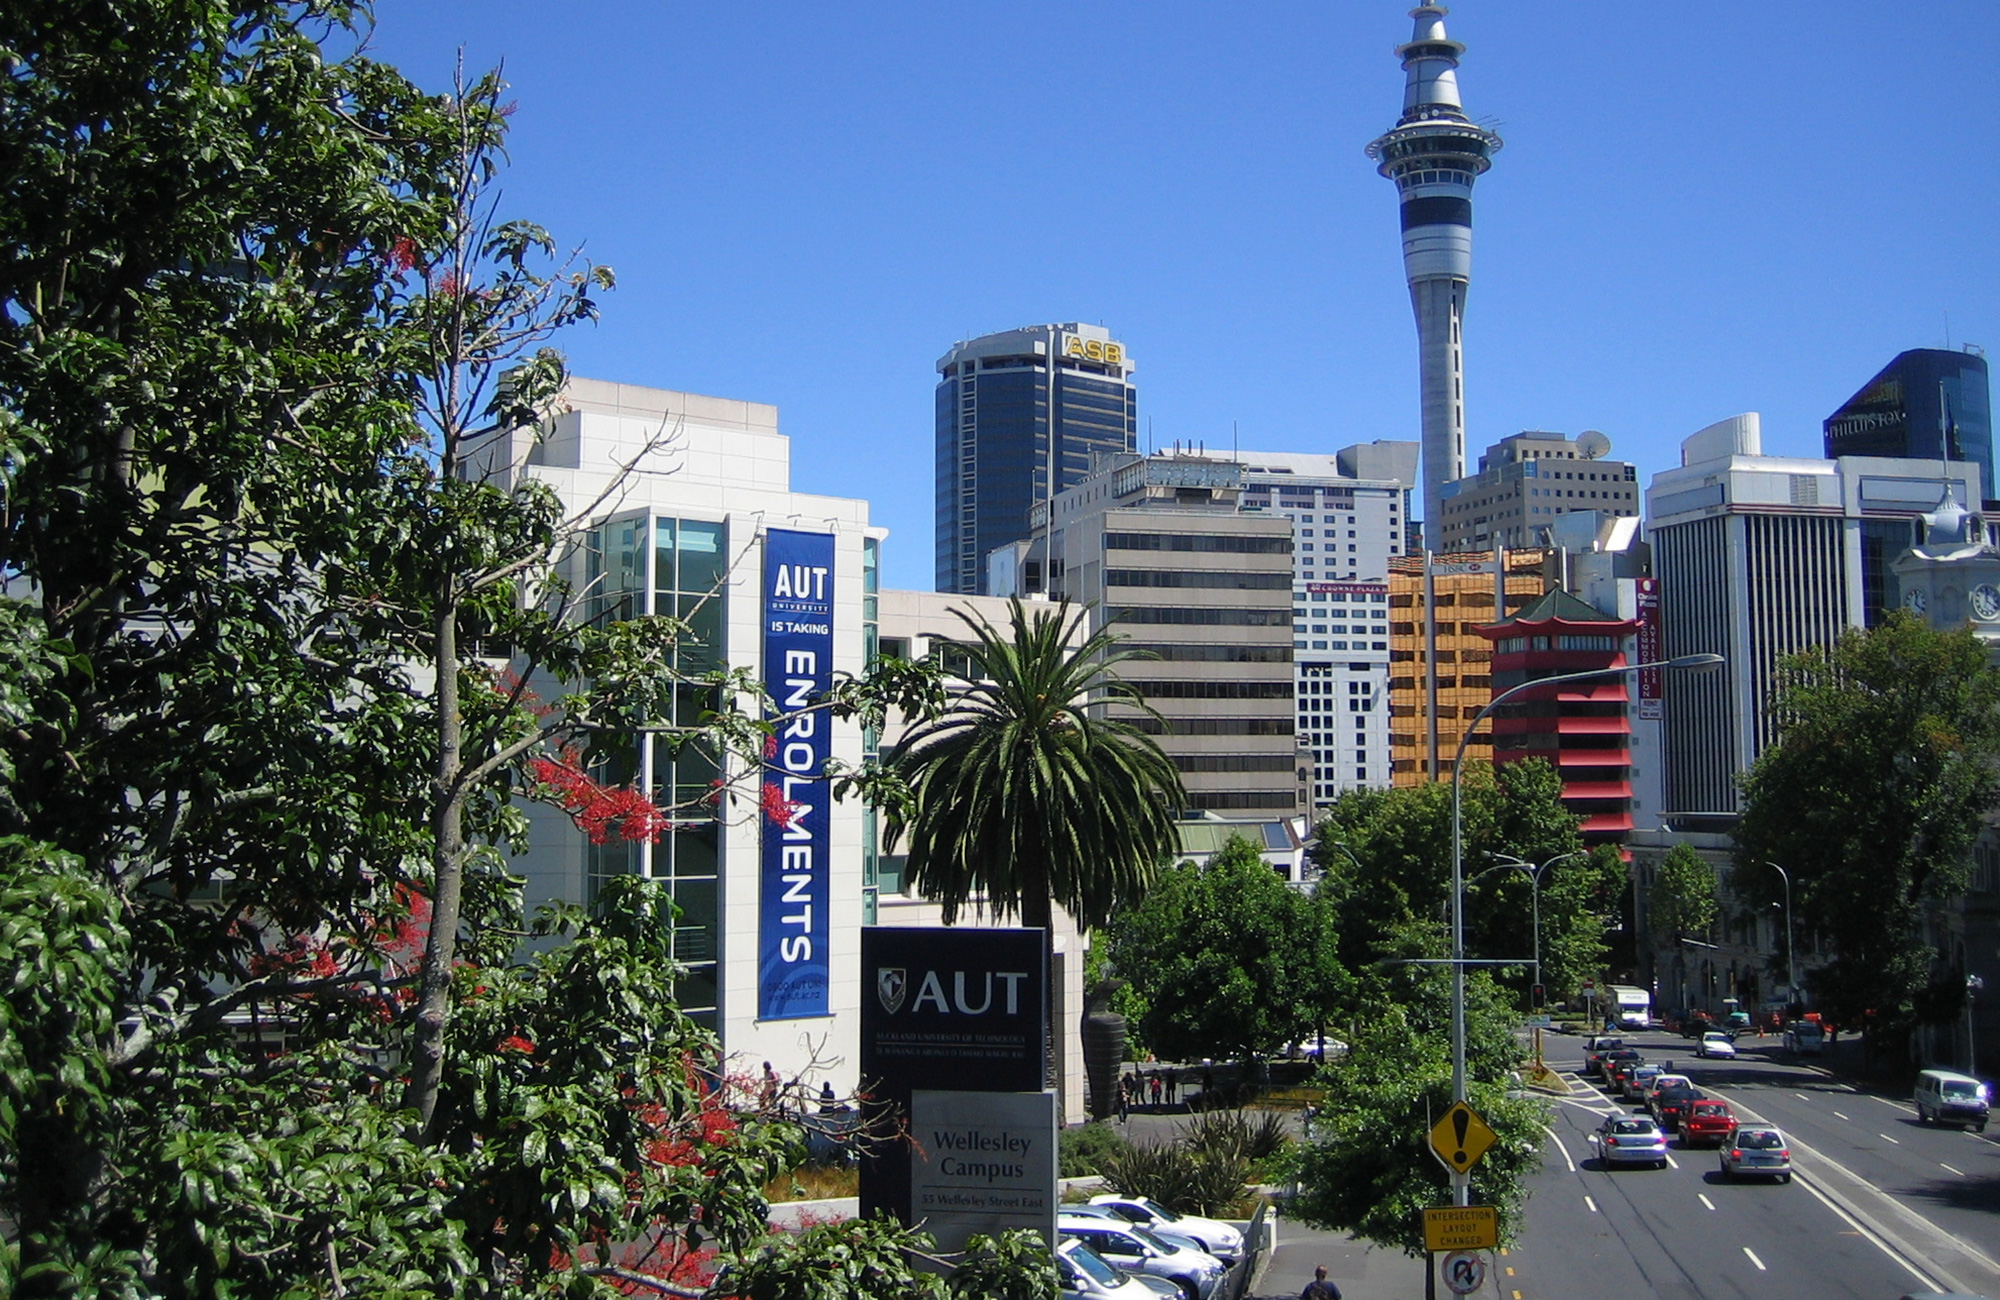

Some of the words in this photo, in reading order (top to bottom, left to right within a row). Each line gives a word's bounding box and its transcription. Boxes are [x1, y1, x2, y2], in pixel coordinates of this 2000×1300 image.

[1066, 335, 1121, 363] ASB
[1877, 410, 1901, 427] FOX
[774, 564, 828, 600] AUT
[772, 602, 828, 612] UNIVERSITY
[772, 621, 784, 632] IS
[785, 622, 829, 635] TAKING
[780, 649, 816, 963] ENROLMENTS
[912, 970, 1028, 1015] AUT
[918, 1033, 960, 1043] UNIVERSITY
[975, 1034, 1026, 1044] TECHNOLOGY
[934, 1131, 1031, 1158] Wellesley
[941, 1157, 1024, 1183] Campus
[922, 1194, 935, 1204] 55
[937, 1194, 986, 1209] Wellesley
[988, 1196, 1019, 1207] Street
[1022, 1197, 1043, 1208] East
[1428, 1211, 1491, 1221] INTERSECTION
[1443, 1224, 1477, 1233] LAYOUT
[1441, 1236, 1482, 1246] CHANGED
